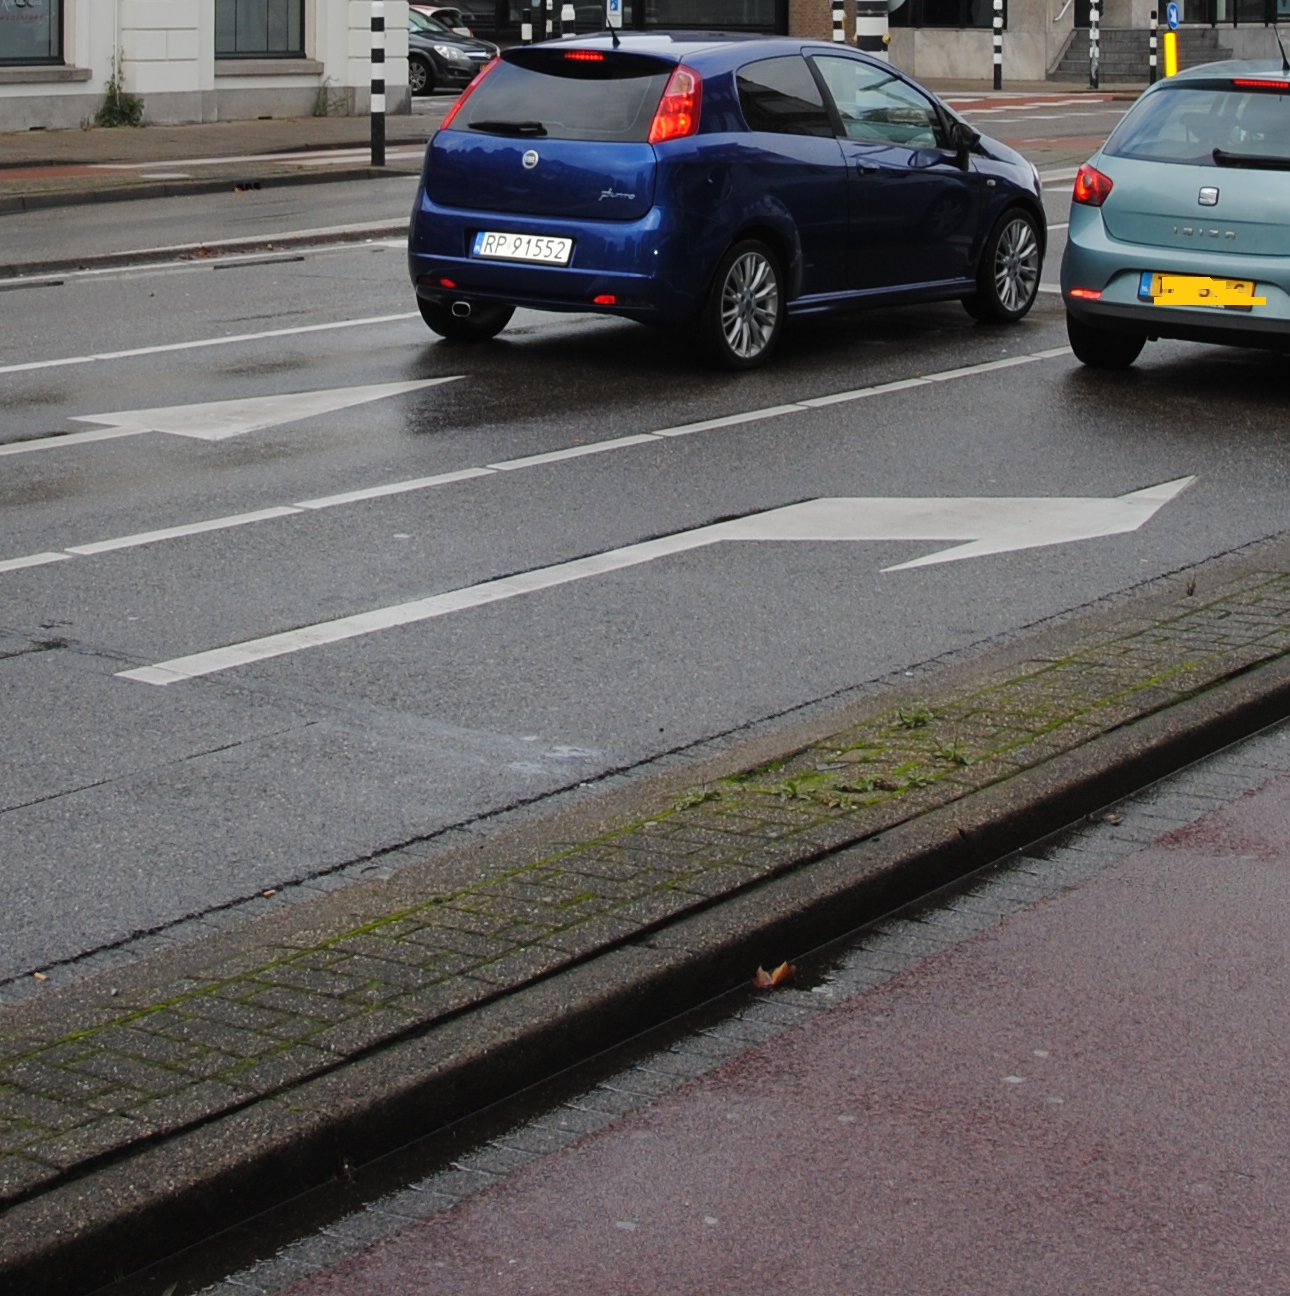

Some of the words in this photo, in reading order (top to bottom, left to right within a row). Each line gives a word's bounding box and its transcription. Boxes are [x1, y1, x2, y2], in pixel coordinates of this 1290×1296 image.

[1173, 226, 1236, 240] IBIZA
[483, 234, 508, 254] RP
[510, 236, 567, 260] 91552
